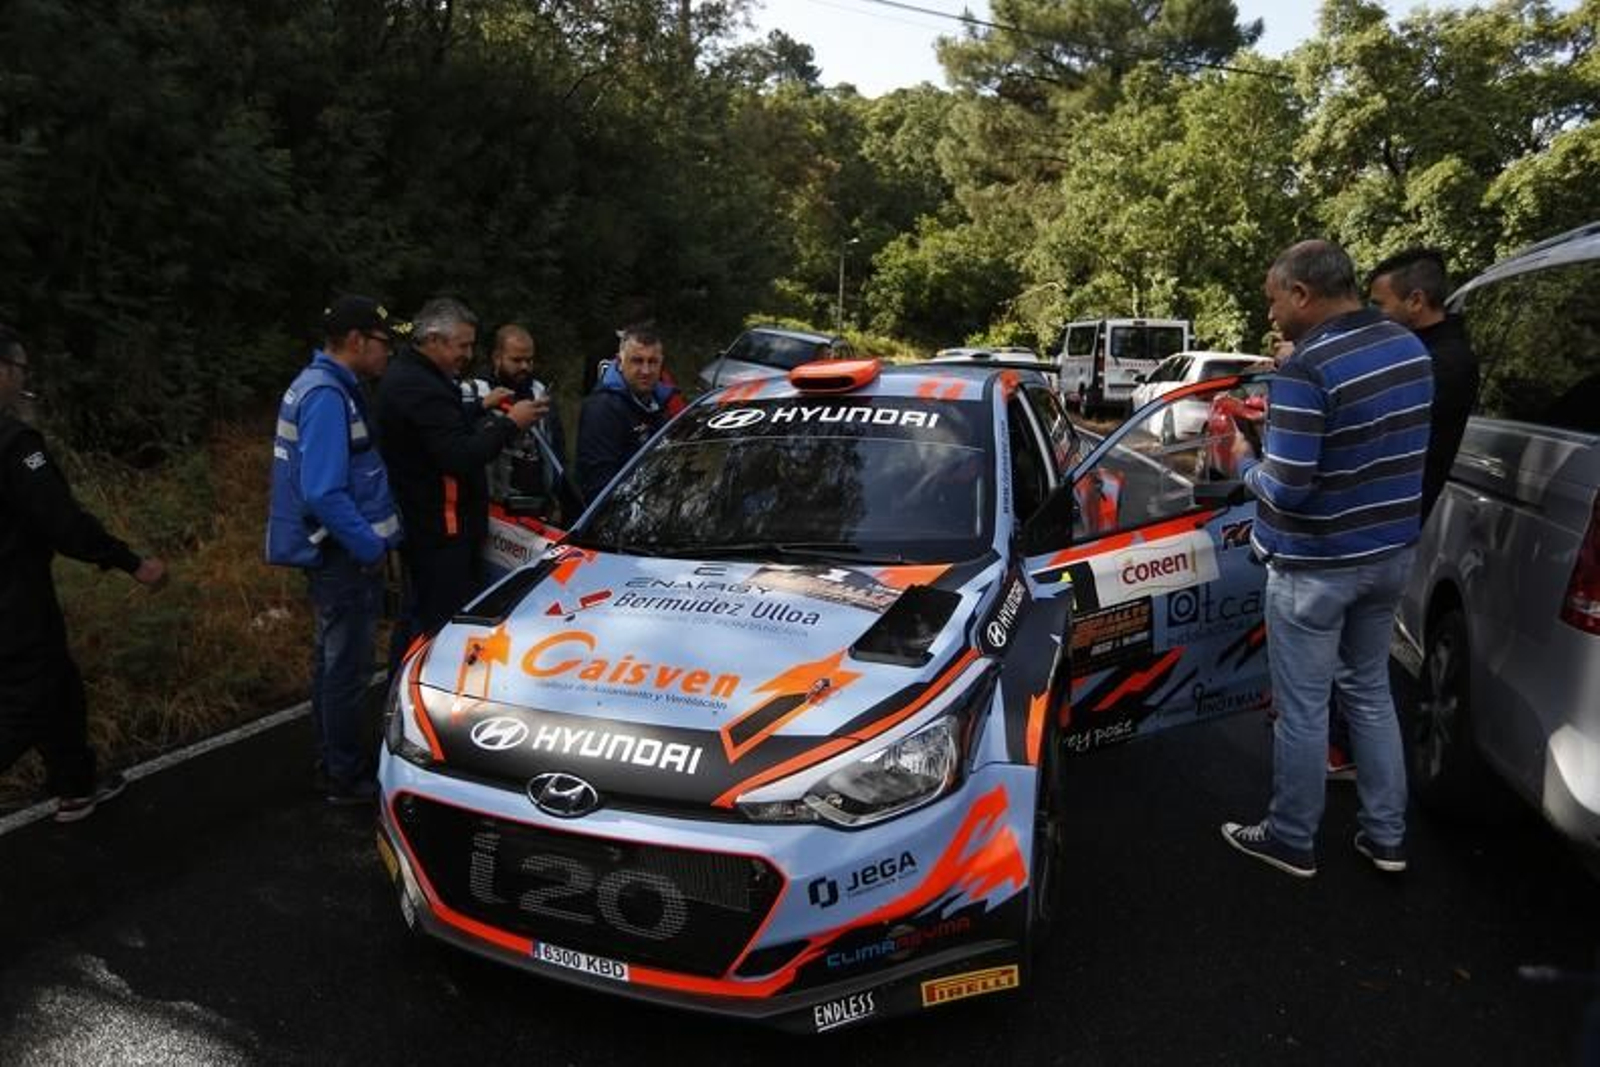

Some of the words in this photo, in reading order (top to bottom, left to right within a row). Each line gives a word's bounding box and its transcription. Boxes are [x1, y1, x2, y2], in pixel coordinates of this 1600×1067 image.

[771, 406, 940, 428] HYUNDAI
[613, 591, 746, 617] Bermudez
[750, 600, 821, 626] Ulloa
[532, 726, 703, 774] HYUNDAI
[544, 945, 580, 968] 6300
[586, 957, 626, 978] KBD
[924, 968, 1016, 1003] PIRELLI
[814, 991, 875, 1027] ENDLESS
